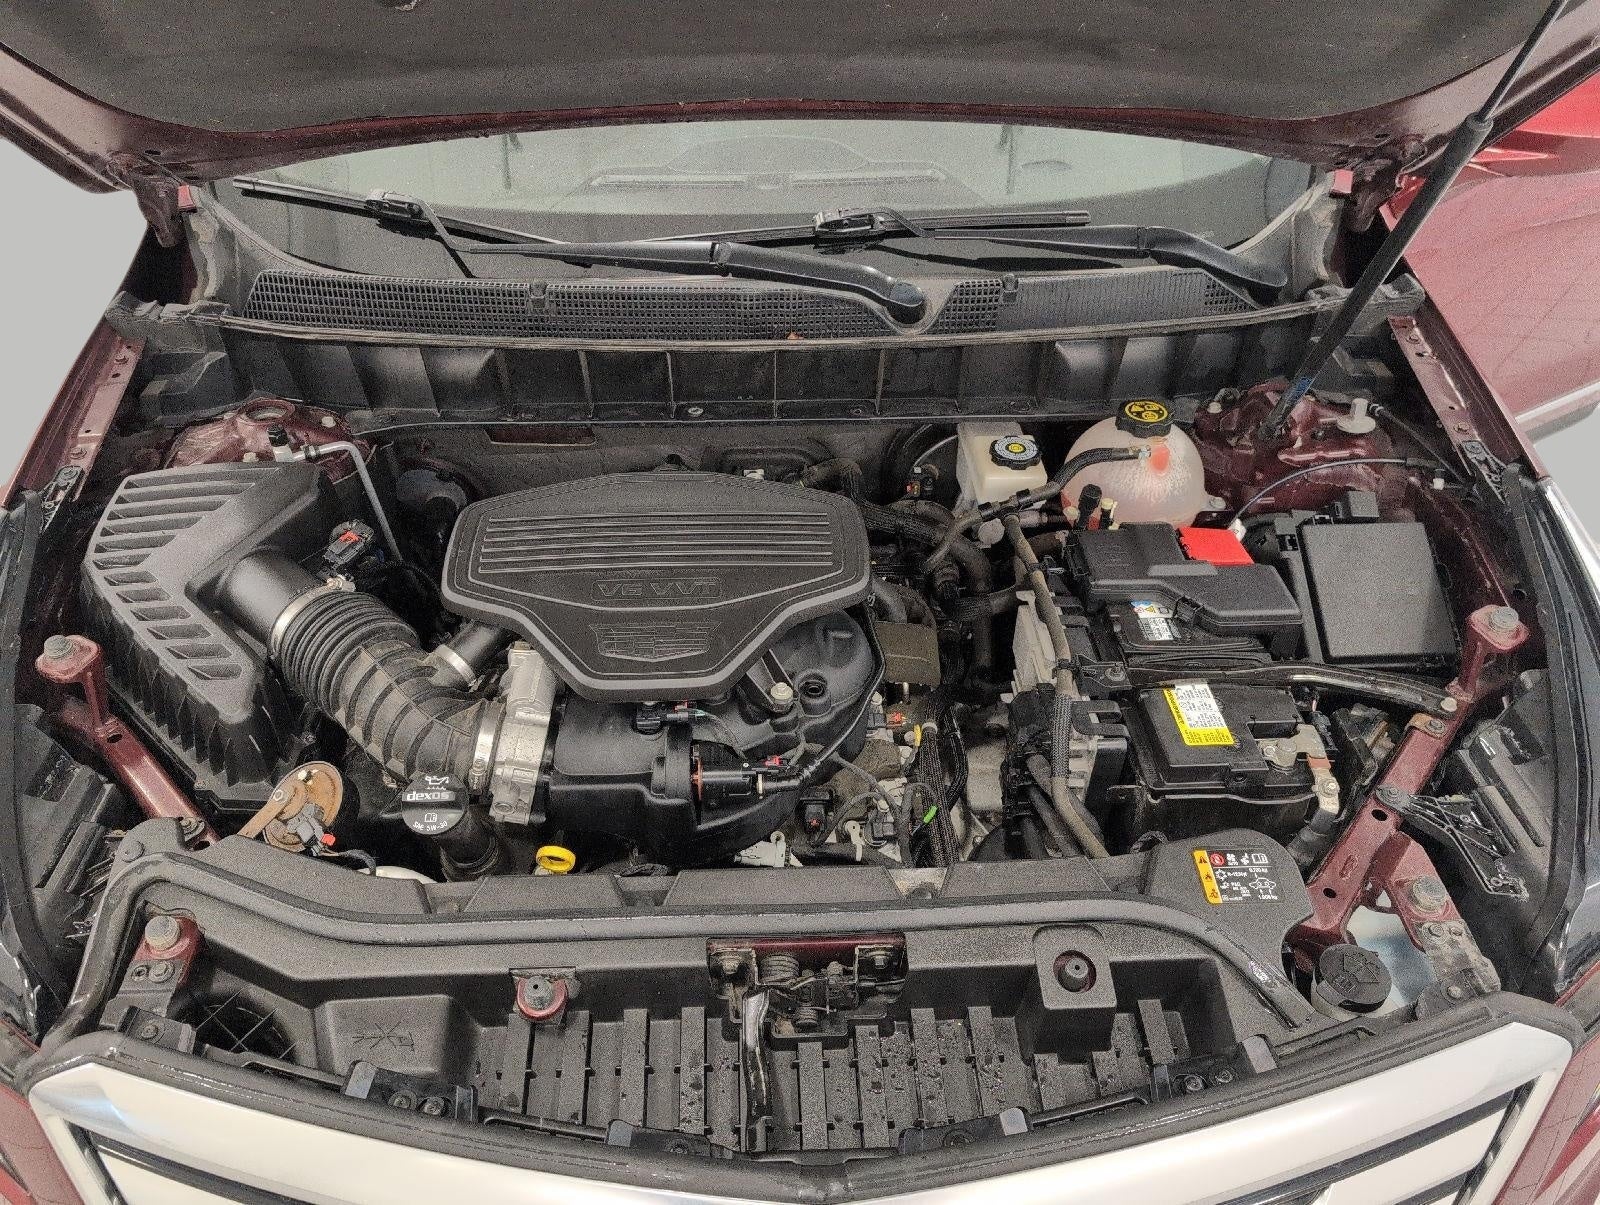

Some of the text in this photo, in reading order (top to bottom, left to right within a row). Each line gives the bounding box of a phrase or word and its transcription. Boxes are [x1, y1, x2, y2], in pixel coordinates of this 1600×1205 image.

[597, 582, 717, 597] V6 VVT
[406, 791, 450, 801] dexos
[412, 820, 448, 832] SAE 5W-30
